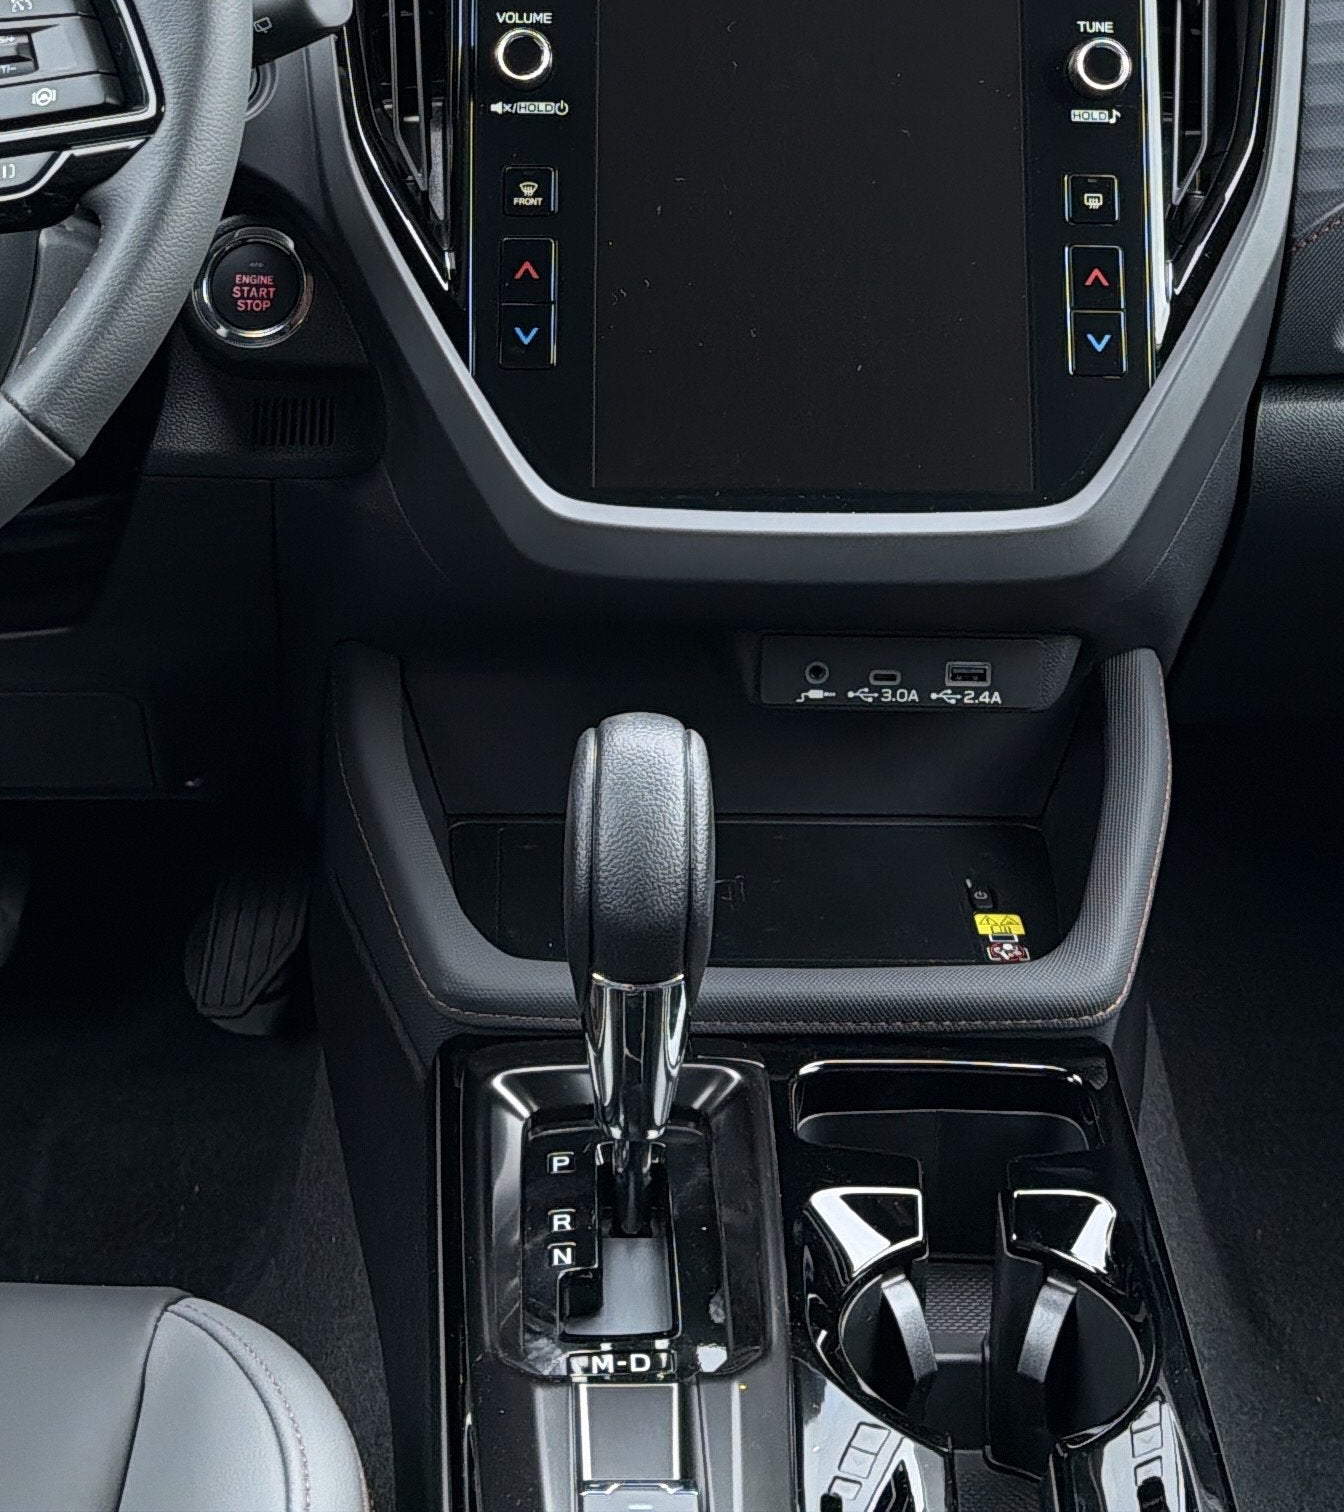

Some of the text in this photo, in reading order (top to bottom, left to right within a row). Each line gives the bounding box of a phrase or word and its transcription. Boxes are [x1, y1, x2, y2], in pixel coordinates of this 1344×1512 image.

[496, 11, 553, 24] VOLUME
[1077, 21, 1114, 34] TUNE
[518, 103, 553, 113] HOLD
[1072, 111, 1106, 121] HOLD
[513, 196, 543, 206] FRONT
[235, 274, 274, 285] ENGINE
[231, 286, 276, 299] START
[237, 299, 272, 312] STOP
[880, 689, 919, 703] 3.0A
[963, 690, 1002, 705] 2.4A
[552, 1156, 571, 1172] P
[553, 1214, 572, 1231] R
[553, 1248, 572, 1265] N
